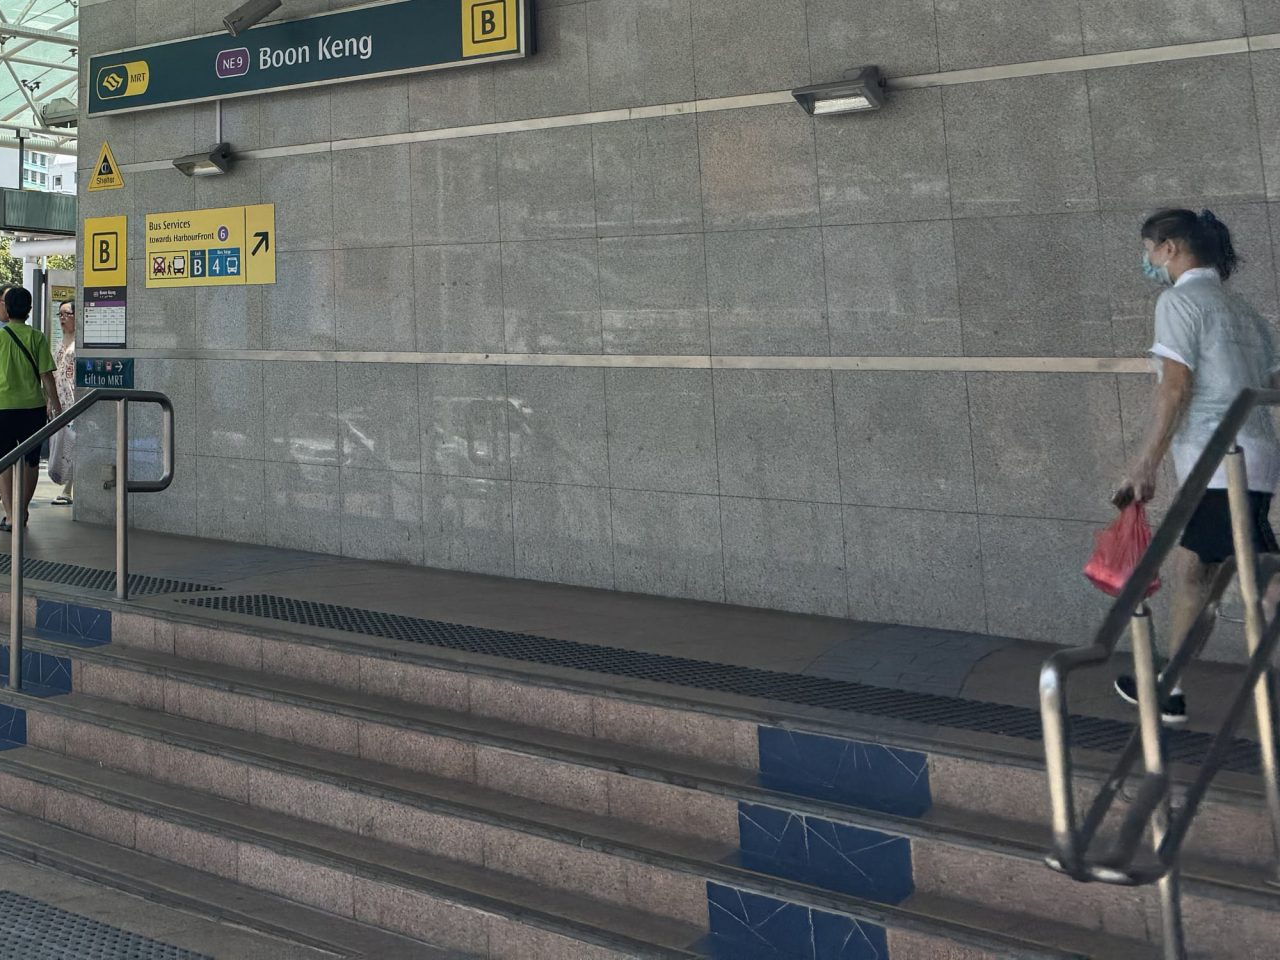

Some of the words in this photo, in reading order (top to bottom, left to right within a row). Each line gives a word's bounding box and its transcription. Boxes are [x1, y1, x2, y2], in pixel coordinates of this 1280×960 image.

[481, 9, 496, 35] B
[258, 45, 310, 70] Boon
[317, 34, 373, 61] Keng
[130, 72, 146, 83] MRT
[149, 221, 162, 231] Bus
[163, 219, 191, 230] Services
[149, 236, 172, 244] towards
[173, 232, 215, 243] HarbourFront
[220, 229, 226, 240] 6
[99, 239, 110, 264] B
[193, 259, 202, 275] B
[212, 258, 220, 274] 4
[98, 375, 106, 385] to
[108, 375, 123, 386] MRT
